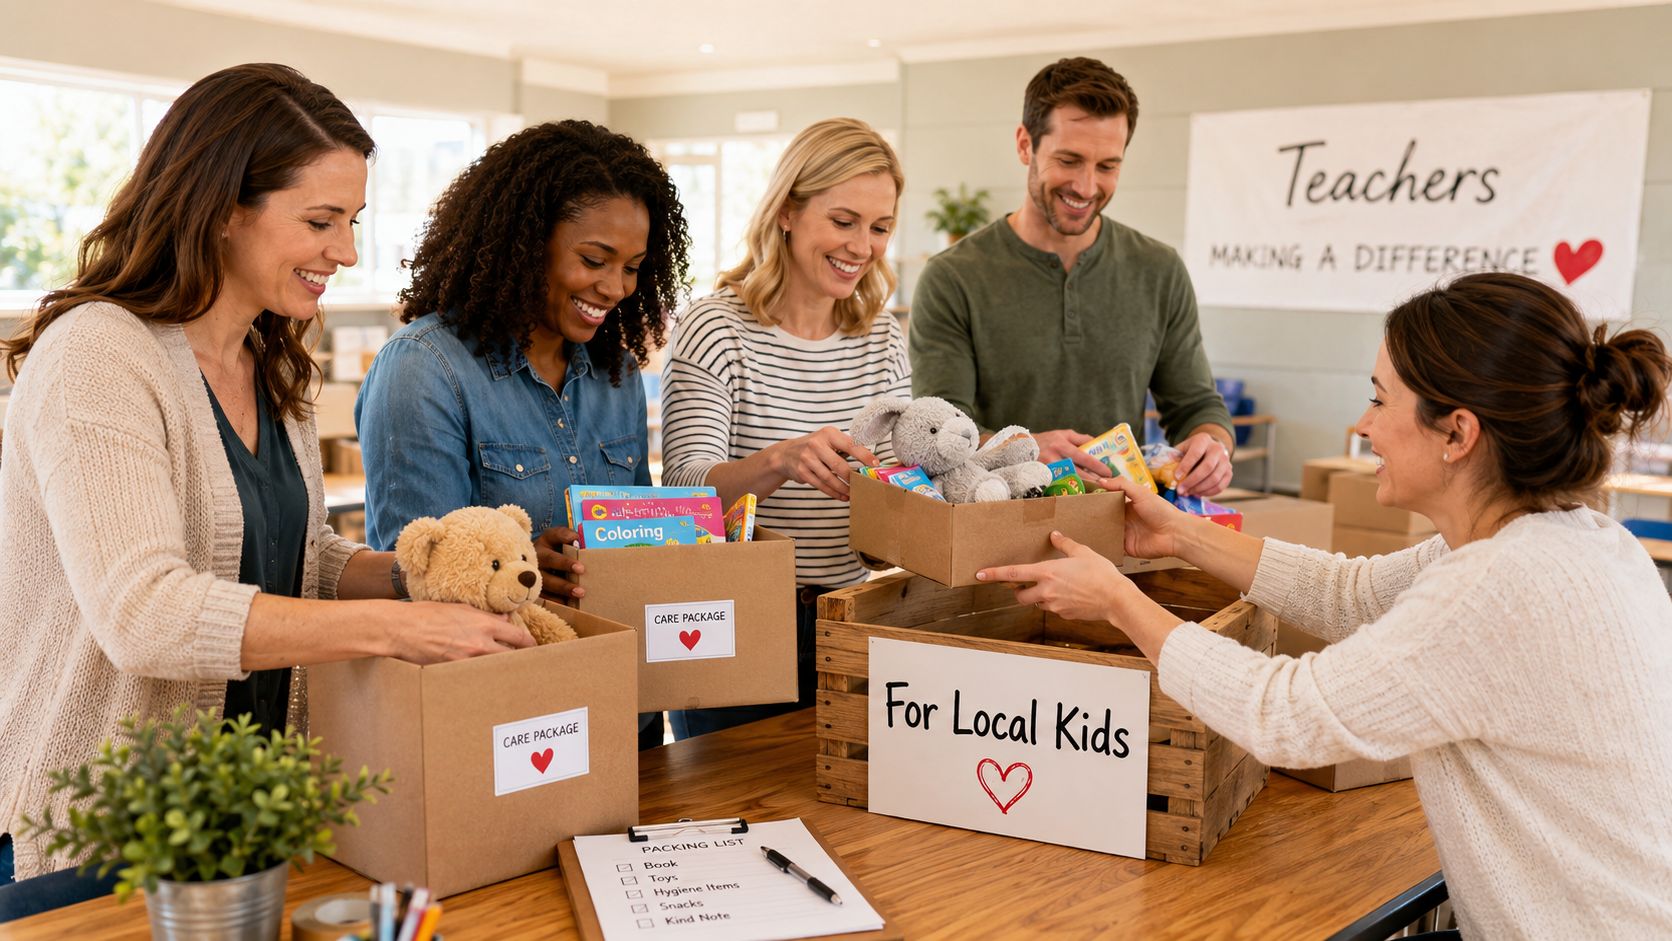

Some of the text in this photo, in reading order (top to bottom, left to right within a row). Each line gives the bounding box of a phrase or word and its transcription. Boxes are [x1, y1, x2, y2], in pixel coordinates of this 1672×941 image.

[1277, 138, 1500, 206] Teachers
[1208, 243, 1539, 274] MAKING A DIFFERENCE
[595, 525, 664, 542] Coloring
[654, 611, 726, 625] CARE PACKAGE
[885, 681, 1129, 758] For Local Kids
[503, 722, 579, 748] CARE PACKAGE
[642, 838, 744, 854] PACKING LIST
[643, 860, 679, 870] Book
[648, 874, 679, 884] Toys
[653, 882, 740, 898] Hygiene Items
[659, 900, 704, 911] Snacks
[664, 912, 731, 925] Kind Note
